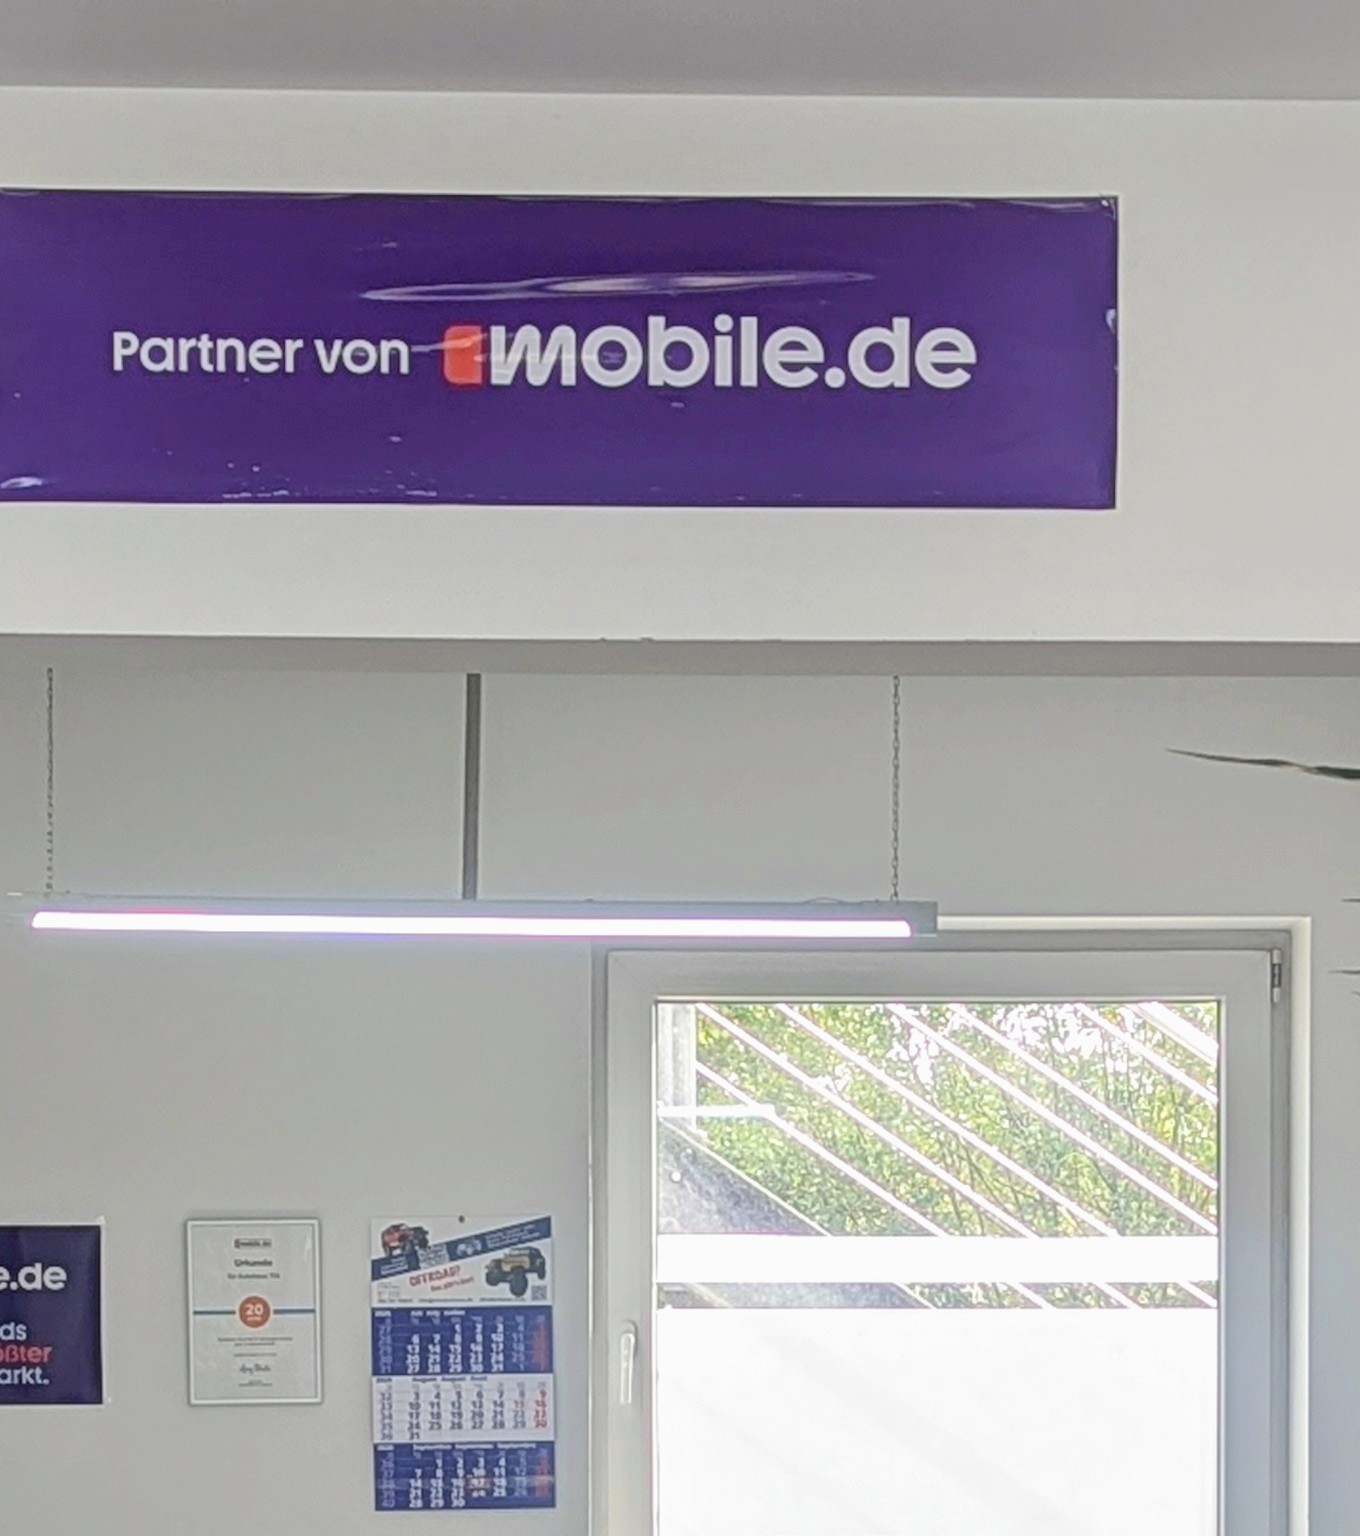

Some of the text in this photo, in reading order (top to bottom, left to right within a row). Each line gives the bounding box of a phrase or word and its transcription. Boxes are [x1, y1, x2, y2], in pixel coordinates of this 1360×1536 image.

[111, 314, 978, 390] Partner von mobile.de
[245, 1304, 264, 1316] 20
